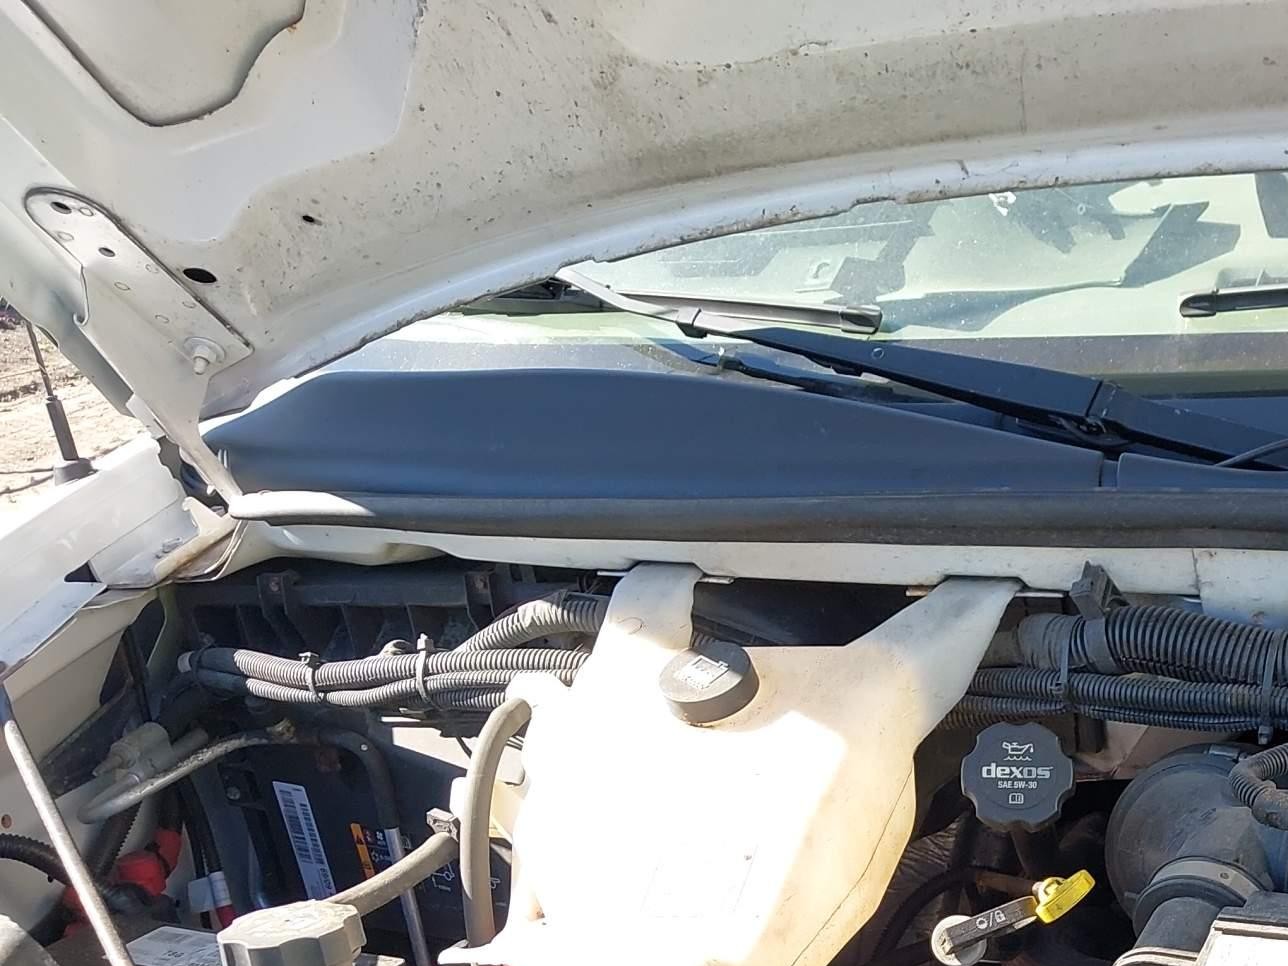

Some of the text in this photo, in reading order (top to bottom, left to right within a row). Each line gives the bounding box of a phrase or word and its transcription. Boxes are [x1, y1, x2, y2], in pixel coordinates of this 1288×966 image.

[982, 763, 1053, 778] dexos
[998, 781, 1037, 789] SAE 5W-30
